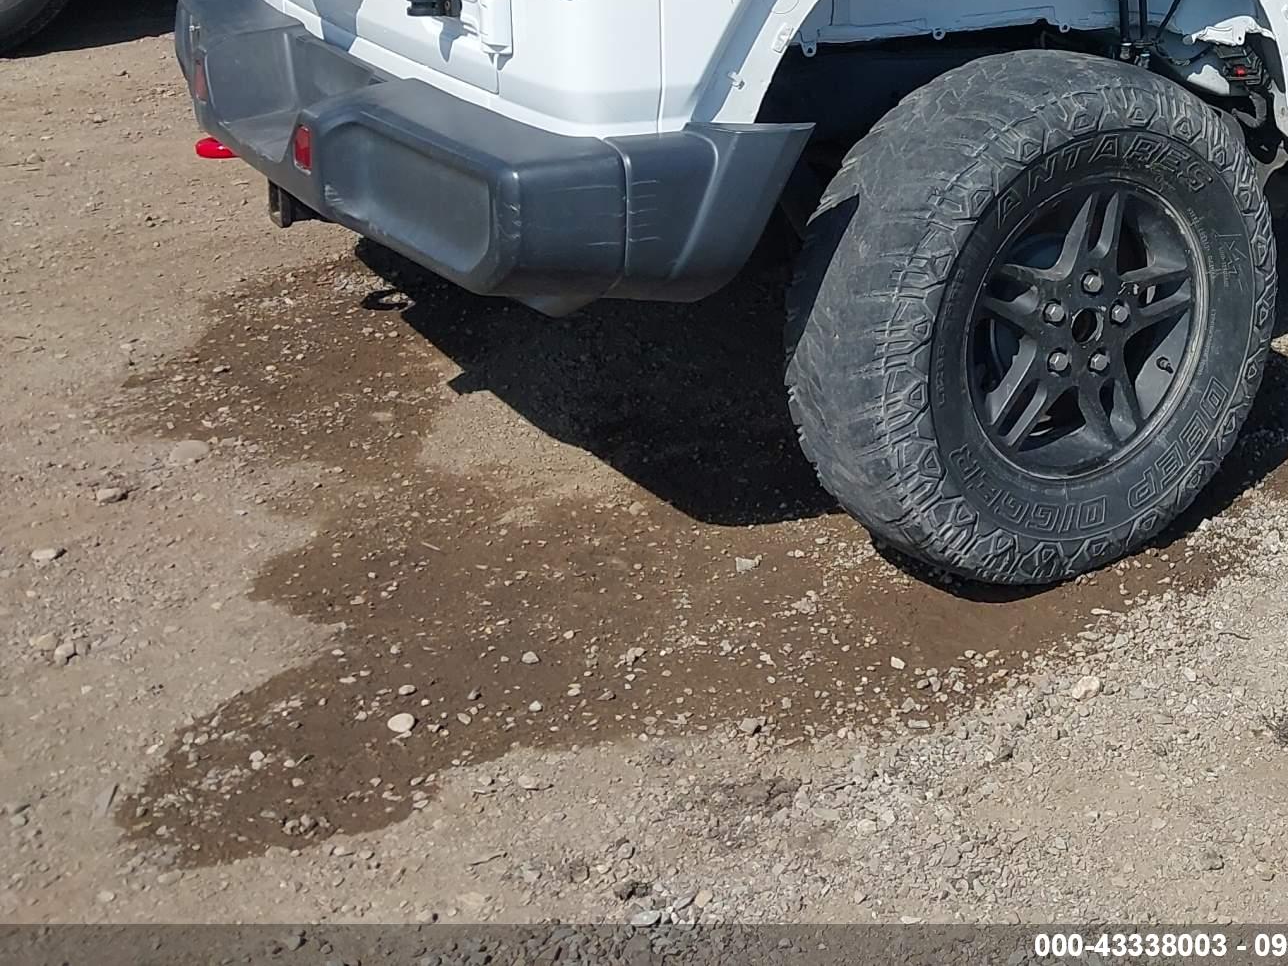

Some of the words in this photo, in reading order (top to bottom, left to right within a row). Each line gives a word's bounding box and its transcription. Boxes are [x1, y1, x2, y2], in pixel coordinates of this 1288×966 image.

[997, 133, 1214, 230] ANTARES
[949, 443, 1109, 533] DIGGER
[1127, 375, 1230, 511] DEEP
